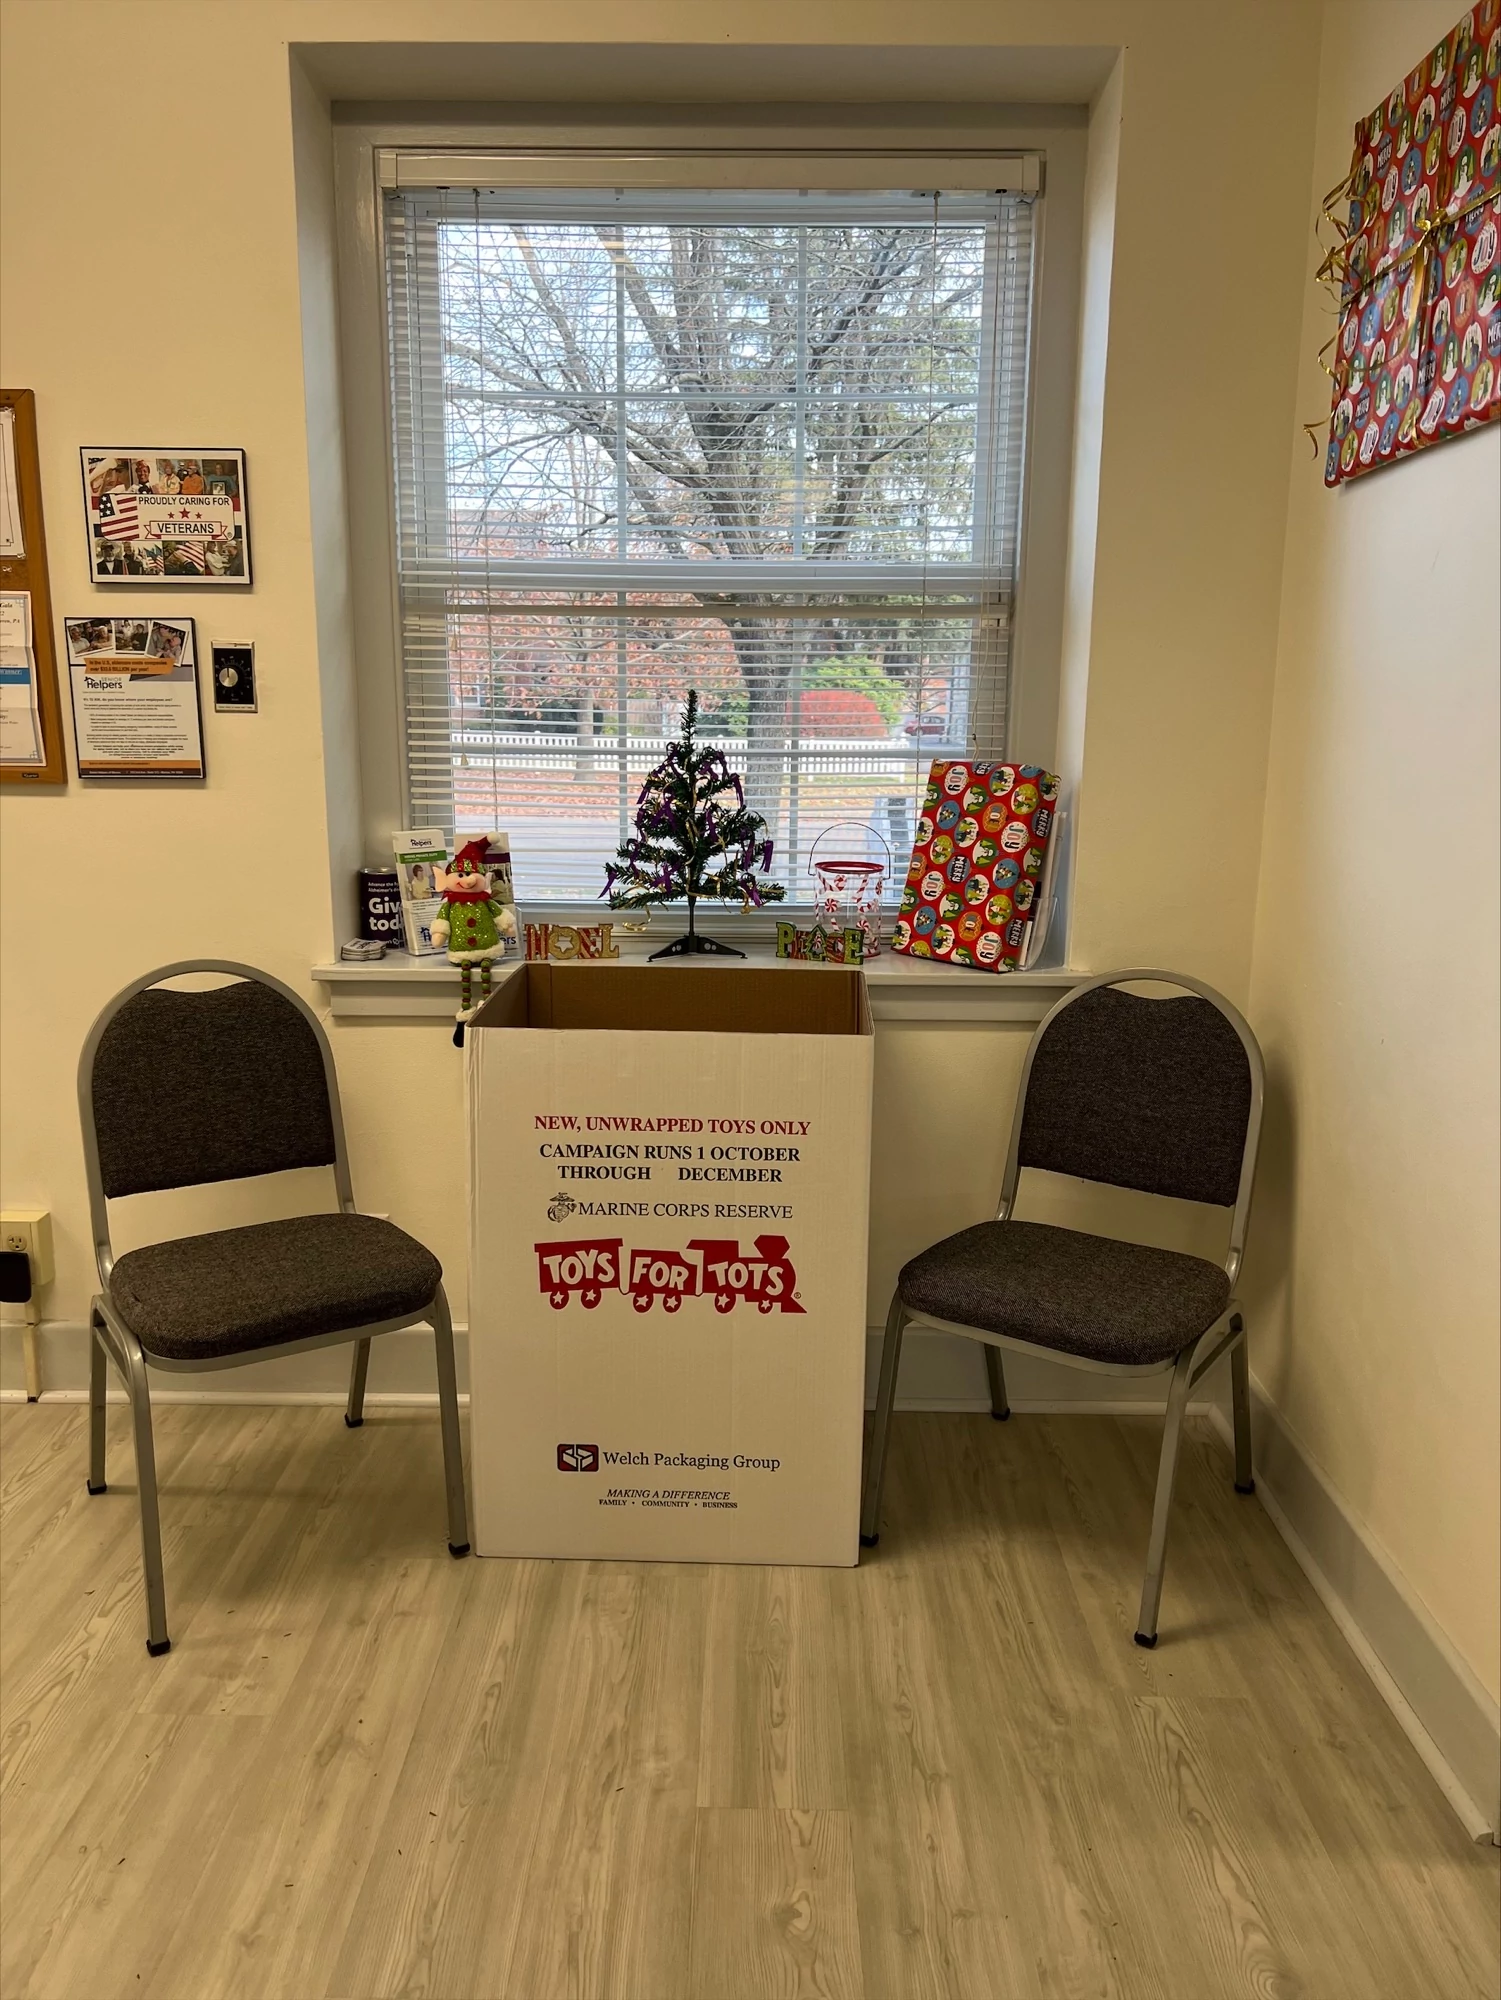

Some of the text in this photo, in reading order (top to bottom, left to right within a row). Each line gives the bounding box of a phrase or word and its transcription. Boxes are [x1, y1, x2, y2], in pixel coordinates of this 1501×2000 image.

[138, 496, 230, 506] PROUDLY CARING FOR
[157, 522, 214, 534] VETERANS
[87, 680, 122, 690] Helpers
[411, 839, 432, 847] Helpers
[369, 896, 401, 914] Giv
[369, 914, 401, 931] tod
[524, 923, 619, 960] NOEL
[776, 922, 864, 965] PEACE
[534, 1116, 811, 1135] NEW, UNWRAPPED TOYS ONLY
[539, 1144, 801, 1162] CAMPAIGN RUNS 1 OCTOBER
[558, 1165, 783, 1183] THROUGH DECEMBER
[578, 1202, 793, 1219] MARINE CORPS RESERVE
[543, 1249, 784, 1296] TOYS FOR TOTS
[603, 1451, 780, 1472] Welch Packaging Group
[607, 1489, 730, 1501] MAKING A DIFFERENCE
[641, 1500, 690, 1508] COMMUNITY
[702, 1501, 738, 1509] BUSINESS
